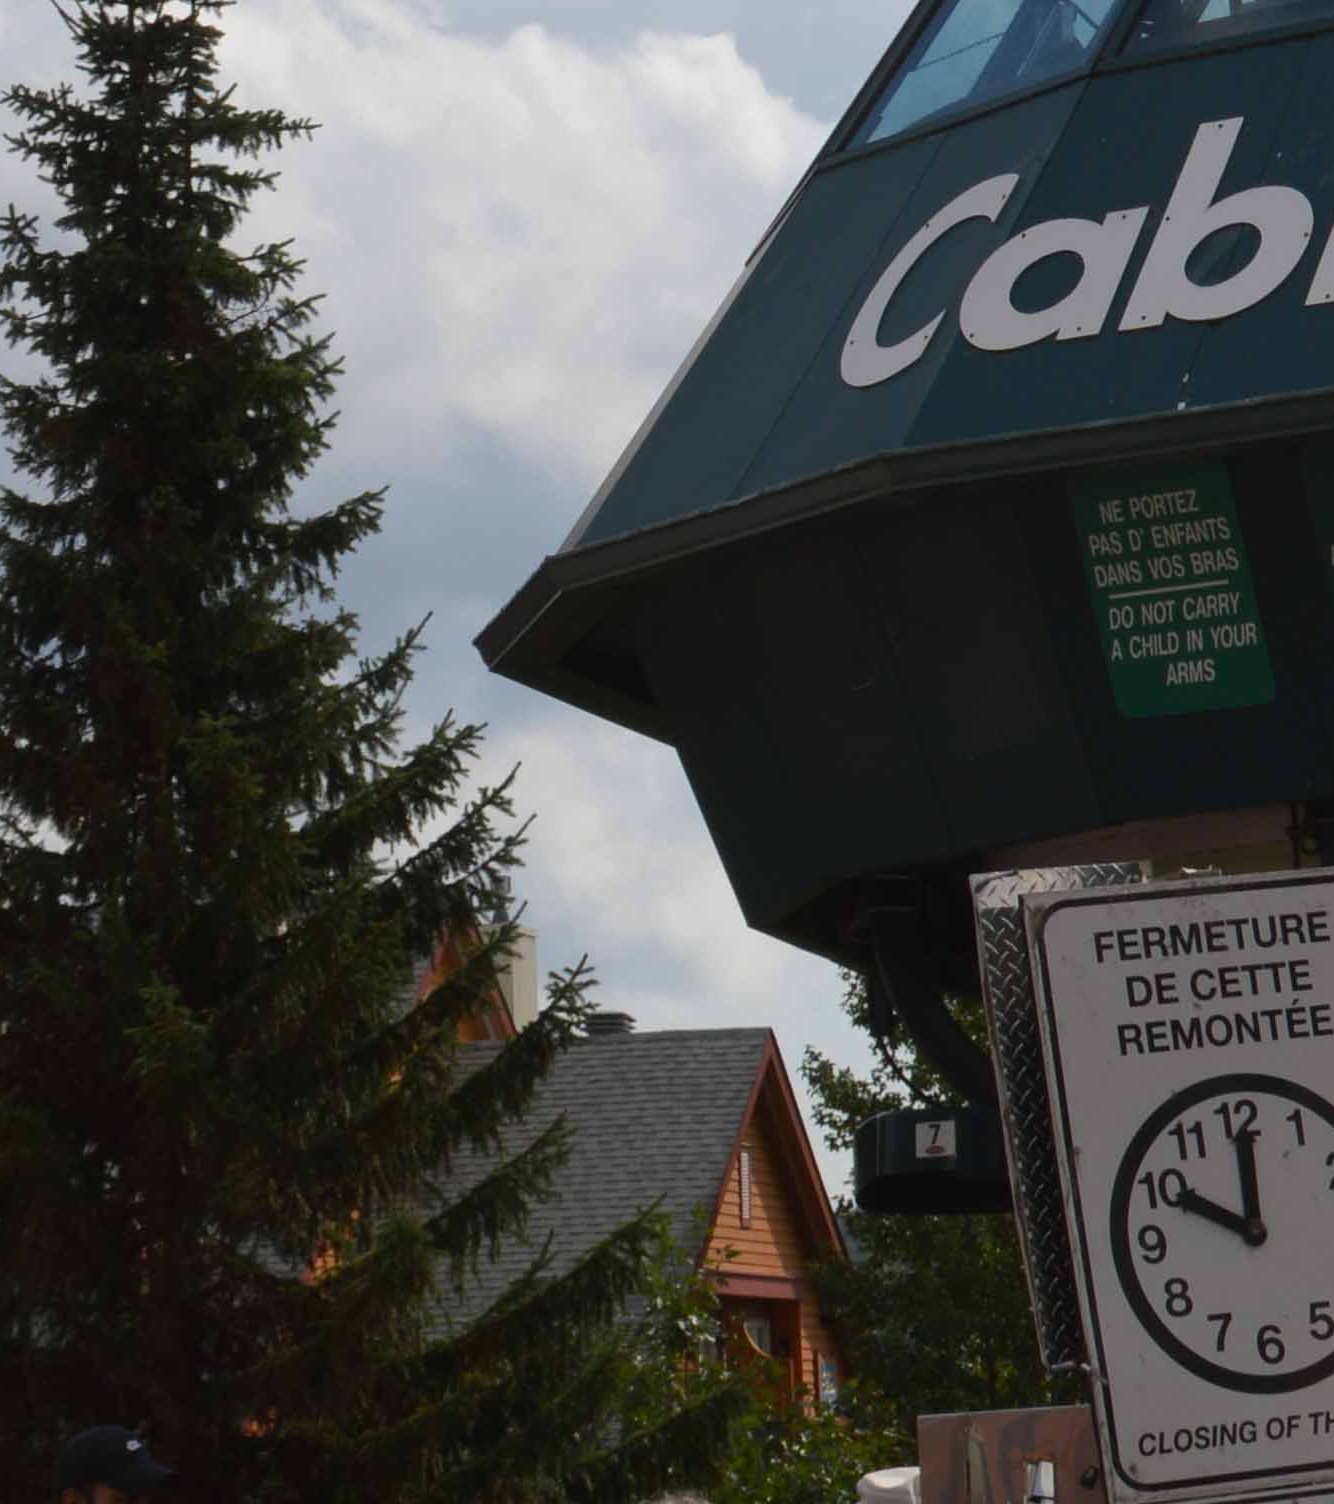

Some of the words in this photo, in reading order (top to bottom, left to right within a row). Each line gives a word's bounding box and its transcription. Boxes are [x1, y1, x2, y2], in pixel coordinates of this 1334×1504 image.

[1099, 501, 1125, 524] NE
[1130, 488, 1200, 518] PORTEZ
[1088, 530, 1122, 557] PAS
[1128, 526, 1146, 551] D'
[1151, 517, 1231, 548] ENFANTS
[1093, 560, 1143, 590] DANS
[1148, 554, 1185, 580] VOS
[1191, 547, 1240, 575] BRAS
[1109, 605, 1135, 631] DO
[1141, 599, 1175, 626] NOT
[1182, 592, 1241, 622] CARRY
[1111, 640, 1124, 662] A
[1129, 631, 1180, 661] CHILD
[1186, 629, 1204, 652] IN
[1211, 622, 1259, 650] YOUR
[1166, 658, 1216, 686] ARMS
[1093, 911, 1331, 963] FERMETURE
[1126, 973, 1178, 1009] DE
[1189, 959, 1314, 1001] CETTE
[1117, 998, 1334, 1056] REMONTÉE
[928, 1124, 941, 1144] 7
[1214, 1099, 1261, 1138] 12
[1286, 1109, 1306, 1146] 1
[1169, 1120, 1208, 1160] 11
[1137, 1168, 1188, 1209] 10
[1137, 1226, 1167, 1265] 9
[1165, 1277, 1194, 1318] 8
[1208, 1313, 1234, 1352] 7
[1309, 1302, 1334, 1340] 5
[1256, 1325, 1285, 1365] 6
[1138, 1421, 1258, 1457] CLOSING
[1265, 1415, 1301, 1440] OF
